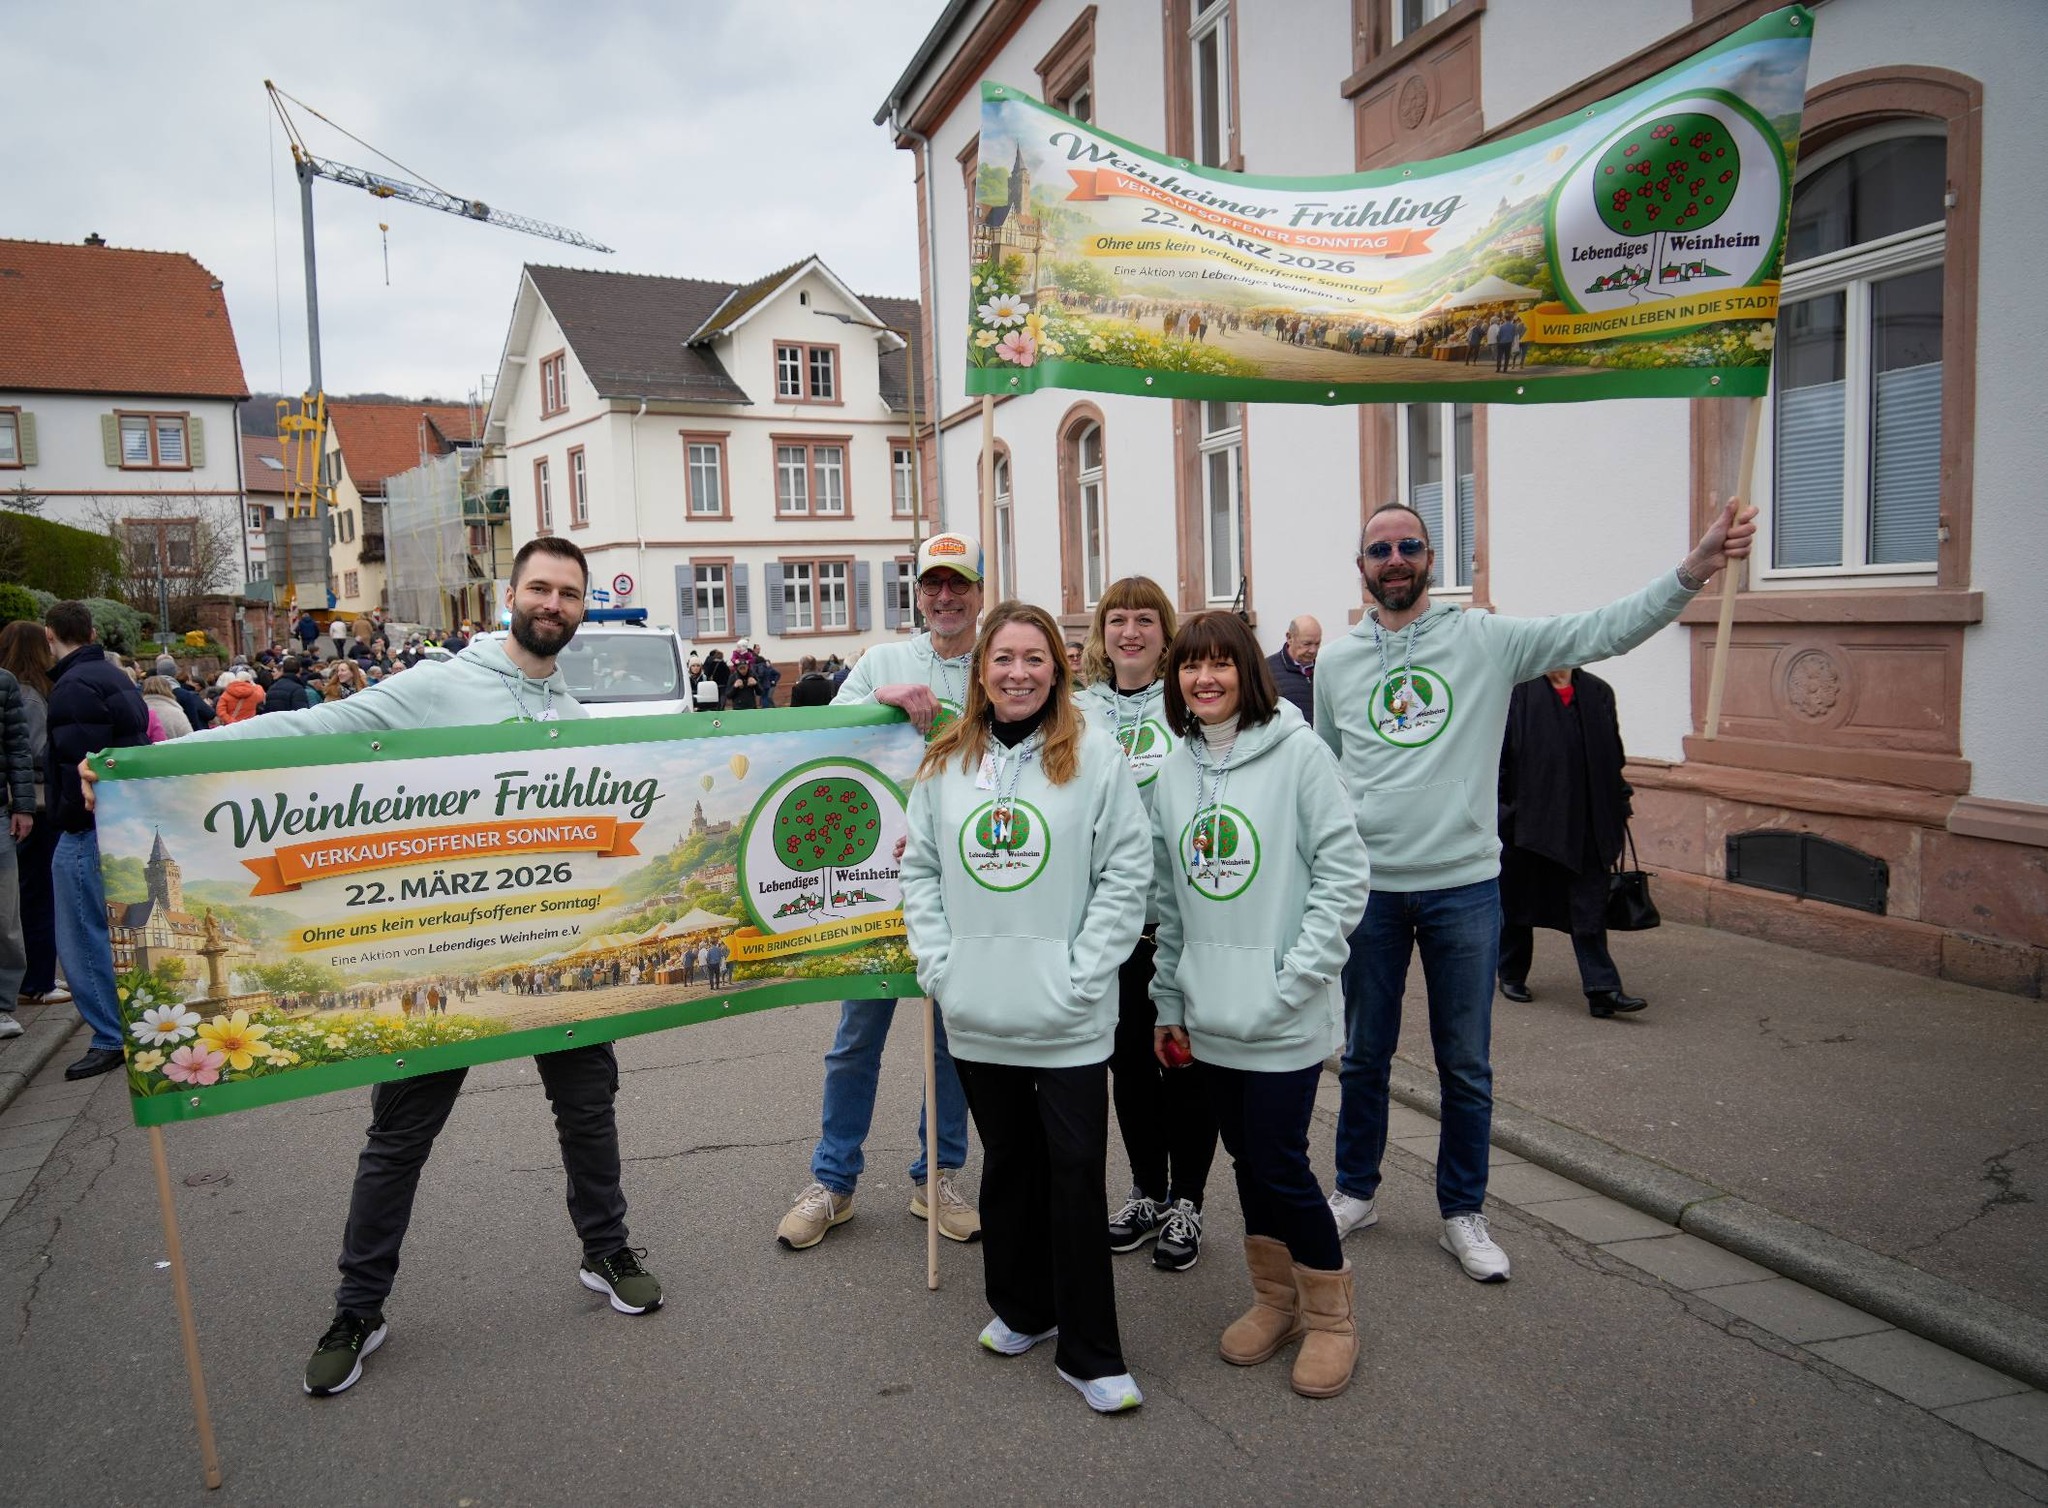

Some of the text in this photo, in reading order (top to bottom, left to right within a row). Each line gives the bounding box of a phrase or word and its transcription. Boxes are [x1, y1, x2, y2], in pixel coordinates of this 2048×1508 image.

[1049, 132, 1468, 228] Weinheimer Frühling
[1115, 176, 1389, 250] VERKAUFSOFFENER SONNTAG
[1140, 207, 1356, 275] 22. MÄRZ 2026
[1571, 232, 1761, 263] Lebendiges Weinheim
[1096, 237, 1384, 296] Ohne uns kein verkaufsoffener Sonntag!
[1114, 265, 1137, 276] Eine
[1139, 266, 1176, 278] Aktion
[1178, 270, 1199, 279] von
[1201, 269, 1269, 287] Lebendiges
[1272, 281, 1334, 300] Weinheim
[1543, 322, 1570, 336] WIR
[1573, 314, 1629, 335] BRINGEN
[1631, 307, 1677, 326] LEBEN
[1680, 305, 1695, 318] IN
[1698, 300, 1722, 316] DIE
[204, 766, 666, 849] Weinheimer Frühling
[301, 824, 597, 868] VERKAUFSOFFENER SONNTAG
[1220, 858, 1251, 866] Weinheim
[345, 862, 573, 907] 22. MÄRZ 2026
[758, 875, 820, 895] Lebendiges
[302, 894, 602, 943] Ohne uns kein verkaufsoffener Sonntag!
[743, 917, 906, 955] WIR BRINGEN LEBEN IN DIE STA
[331, 924, 581, 967] Eine Aktion von Lebendiges Weinheim e.V.
